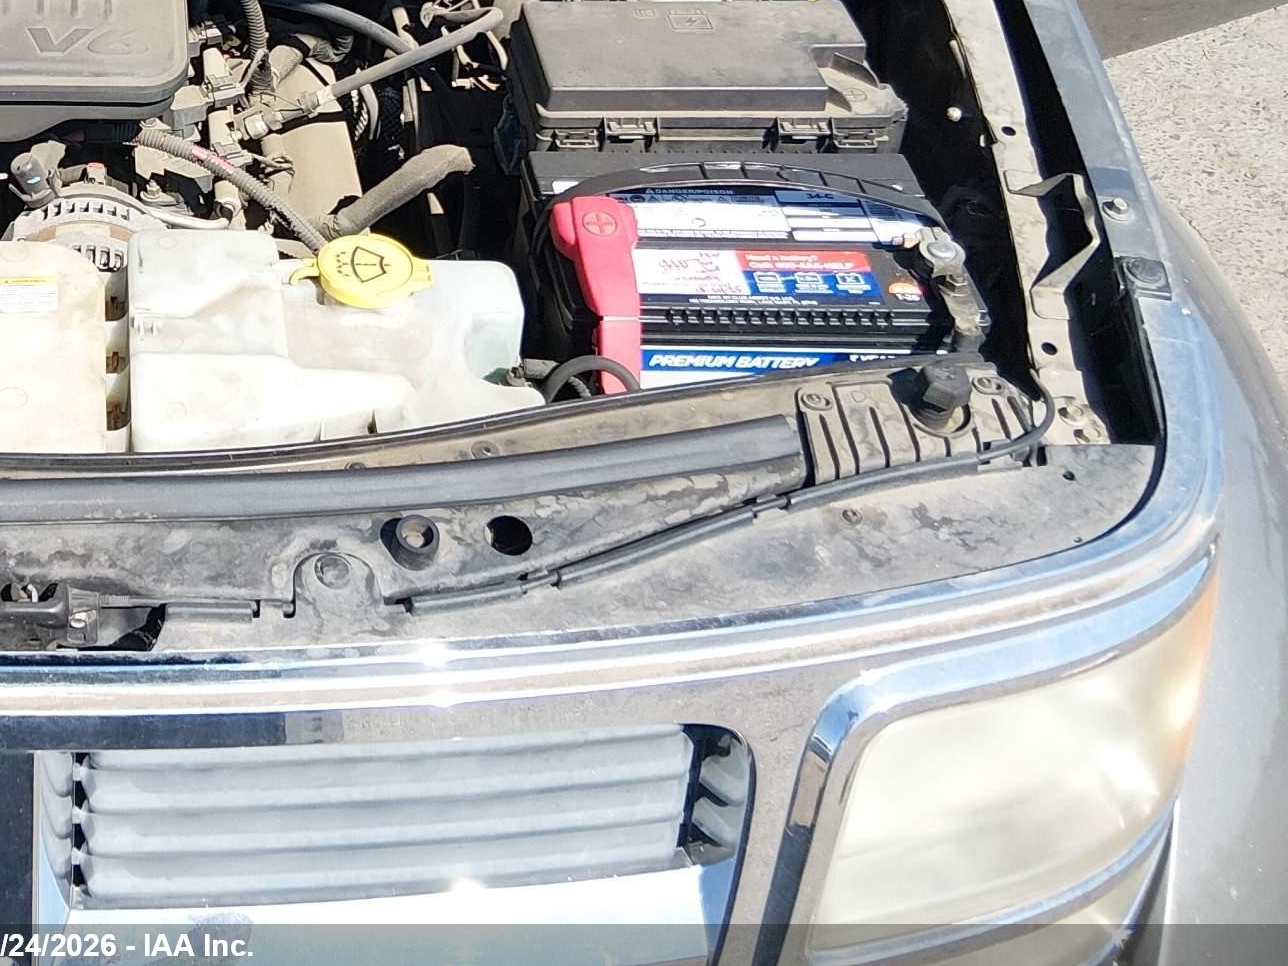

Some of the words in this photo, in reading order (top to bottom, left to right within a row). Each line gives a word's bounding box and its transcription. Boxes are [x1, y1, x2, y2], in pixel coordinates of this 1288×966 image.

[25, 27, 150, 56] V6
[648, 353, 734, 368] PREMIUM
[735, 355, 820, 369] BATTERY
